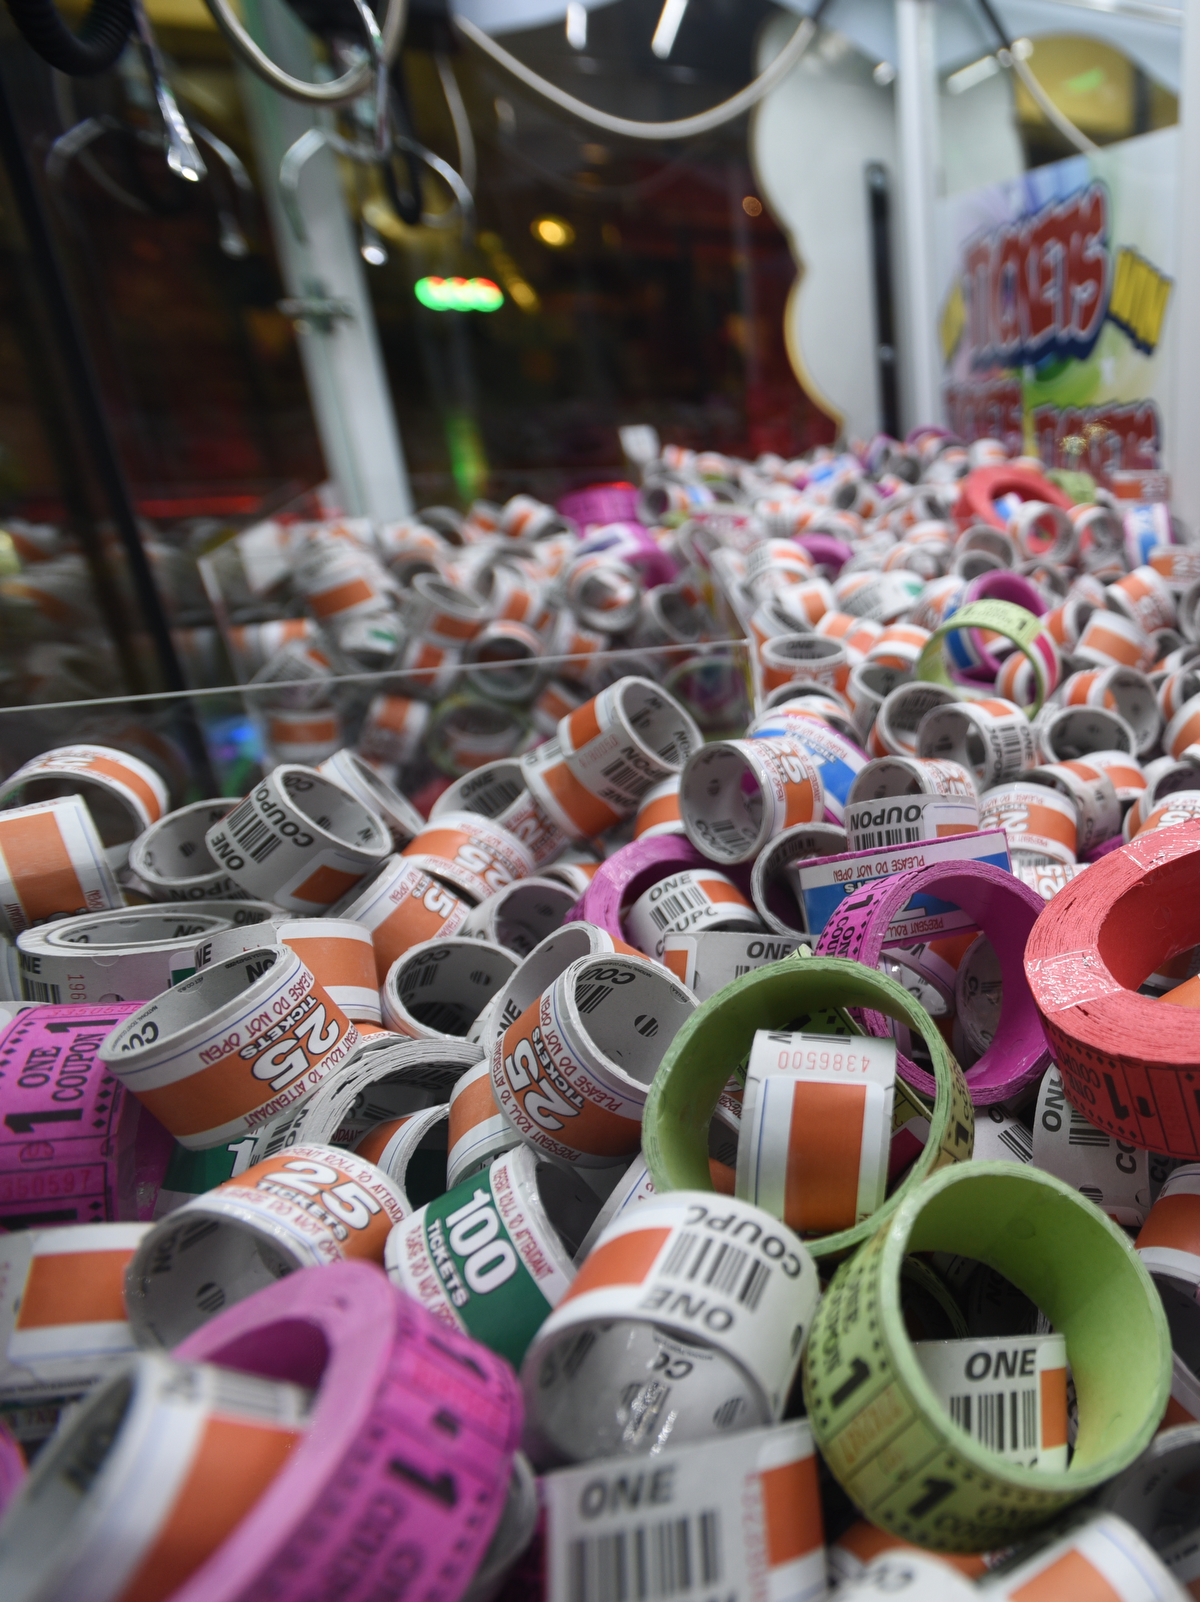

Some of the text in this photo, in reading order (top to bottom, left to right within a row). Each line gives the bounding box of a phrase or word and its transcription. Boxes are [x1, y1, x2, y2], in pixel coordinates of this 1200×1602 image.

[458, 771, 496, 798] ONE
[253, 782, 315, 849] COUPO
[850, 804, 929, 832] OUPON
[210, 831, 246, 872] ONE
[453, 843, 516, 893] 25
[832, 855, 926, 884] PLEASE DO NOT OPEN
[649, 872, 693, 903] ONE
[909, 917, 945, 938] PRESENT
[43, 1018, 120, 1034] 1
[237, 994, 319, 1060] TICKETS
[247, 1007, 275, 1034] NOT
[273, 996, 291, 1015] DO
[16, 1045, 63, 1089] ONE
[51, 1031, 108, 1102] COUPON
[198, 1032, 242, 1066] OPEN
[251, 1003, 341, 1093] 25
[531, 1025, 588, 1110] TICKETS
[539, 994, 624, 1113] OPEN NOT DO PLEASE
[777, 1050, 870, 1073] 4386500
[243, 1046, 348, 1130] ROLL TO ATTENDANT
[503, 1036, 583, 1133] 25
[1102, 1072, 1131, 1121] 1
[3, 1107, 84, 1135] 1
[499, 1088, 514, 1106] TO
[508, 1103, 534, 1134] ROLL
[529, 1127, 583, 1163] PRESENT
[324, 1151, 353, 1174] ROLL
[354, 1168, 374, 1186] TO
[255, 1180, 349, 1243] TICKETS
[262, 1159, 383, 1232] 25
[266, 1197, 326, 1238] DO NOT
[426, 1216, 472, 1309] TICKETS
[444, 1186, 519, 1296] 100
[514, 1226, 556, 1281] ATTENDANT
[639, 1284, 735, 1332] ONE
[829, 1357, 872, 1410] 1
[963, 1349, 1037, 1382] ONE
[389, 1456, 461, 1513] 1
[576, 1461, 680, 1523] ONE
[906, 1475, 957, 1521] 1
